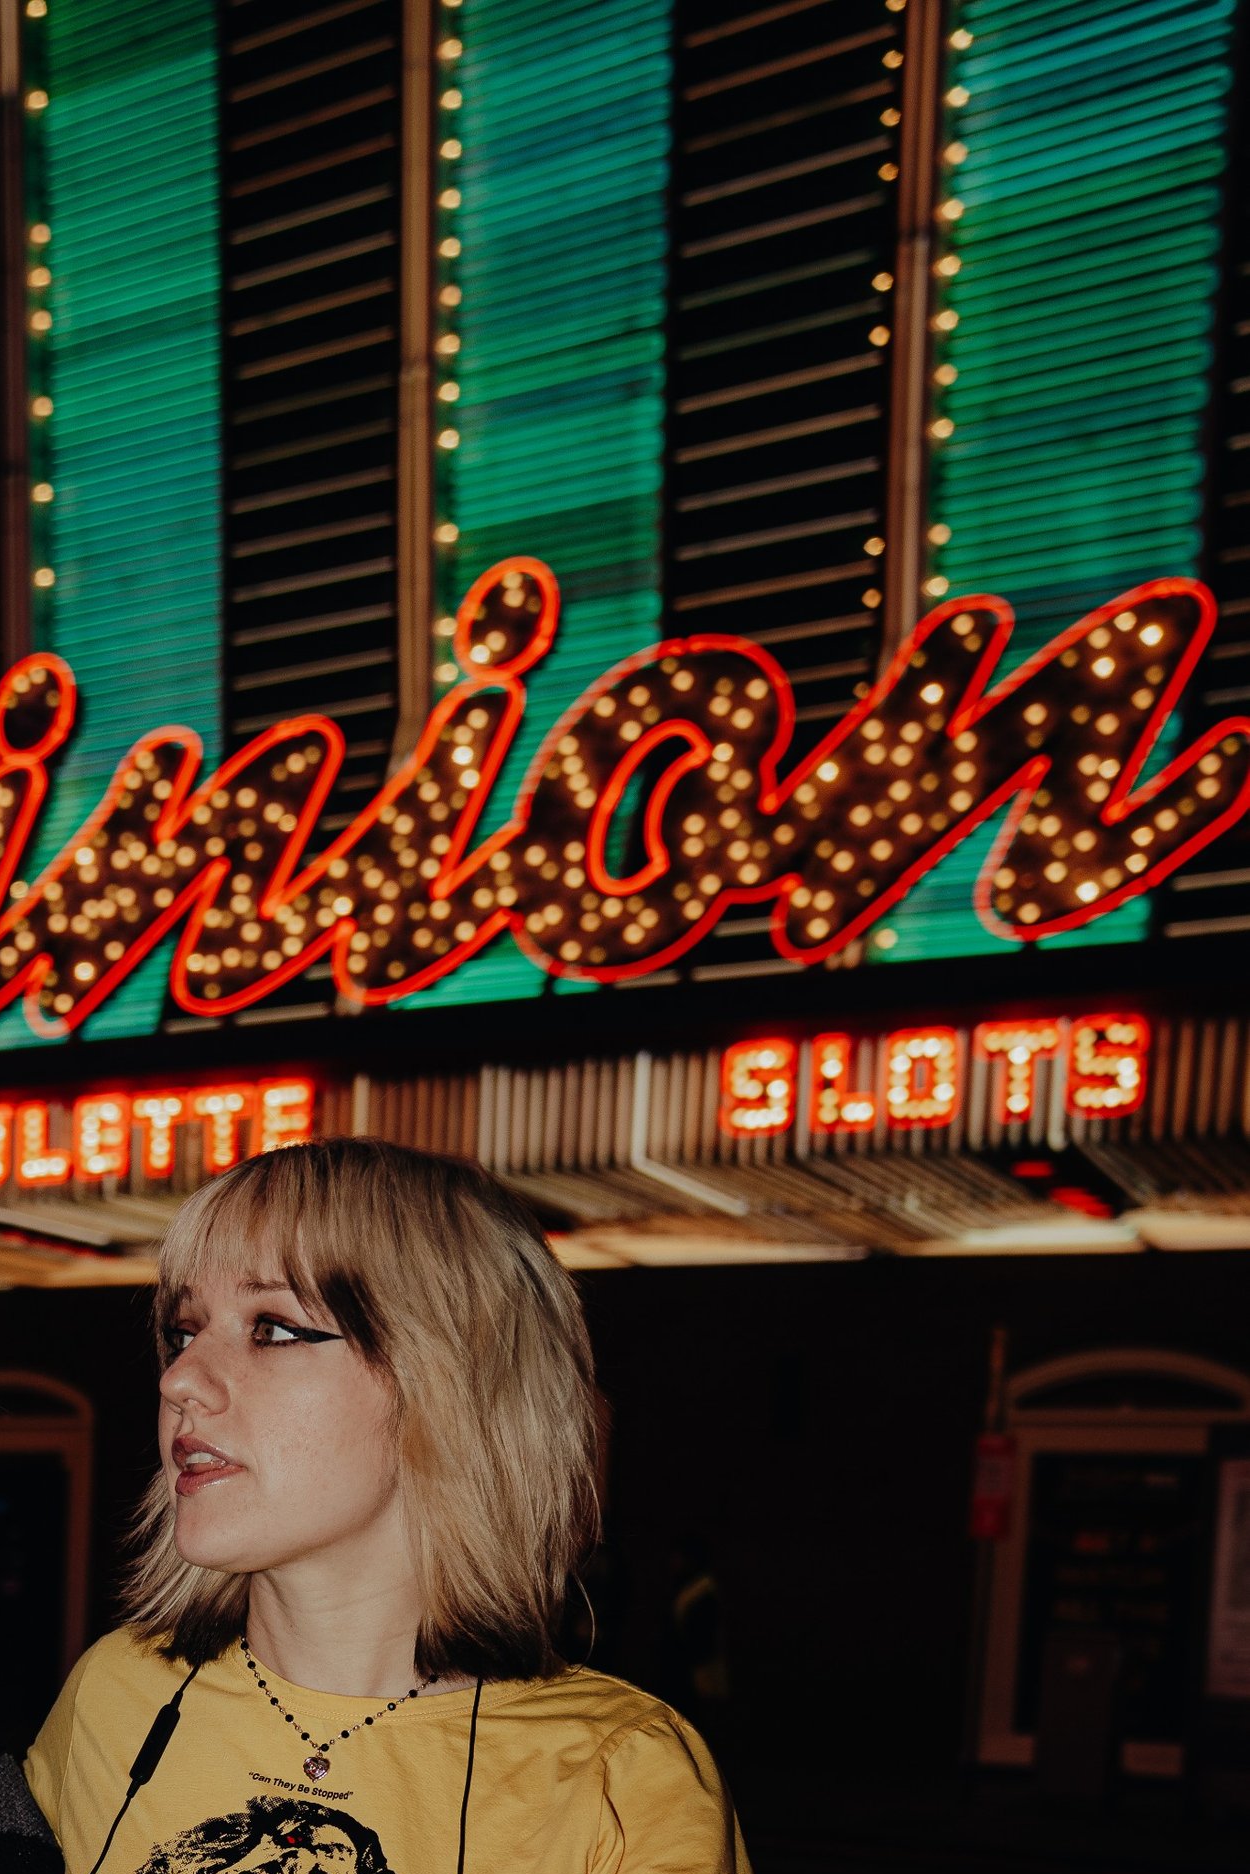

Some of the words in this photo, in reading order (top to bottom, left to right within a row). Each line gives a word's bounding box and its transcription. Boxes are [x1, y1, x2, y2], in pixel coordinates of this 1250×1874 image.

[720, 1014, 1148, 1138] SLOTS
[273, 1778, 296, 1792] They
[297, 1784, 310, 1793] Be
